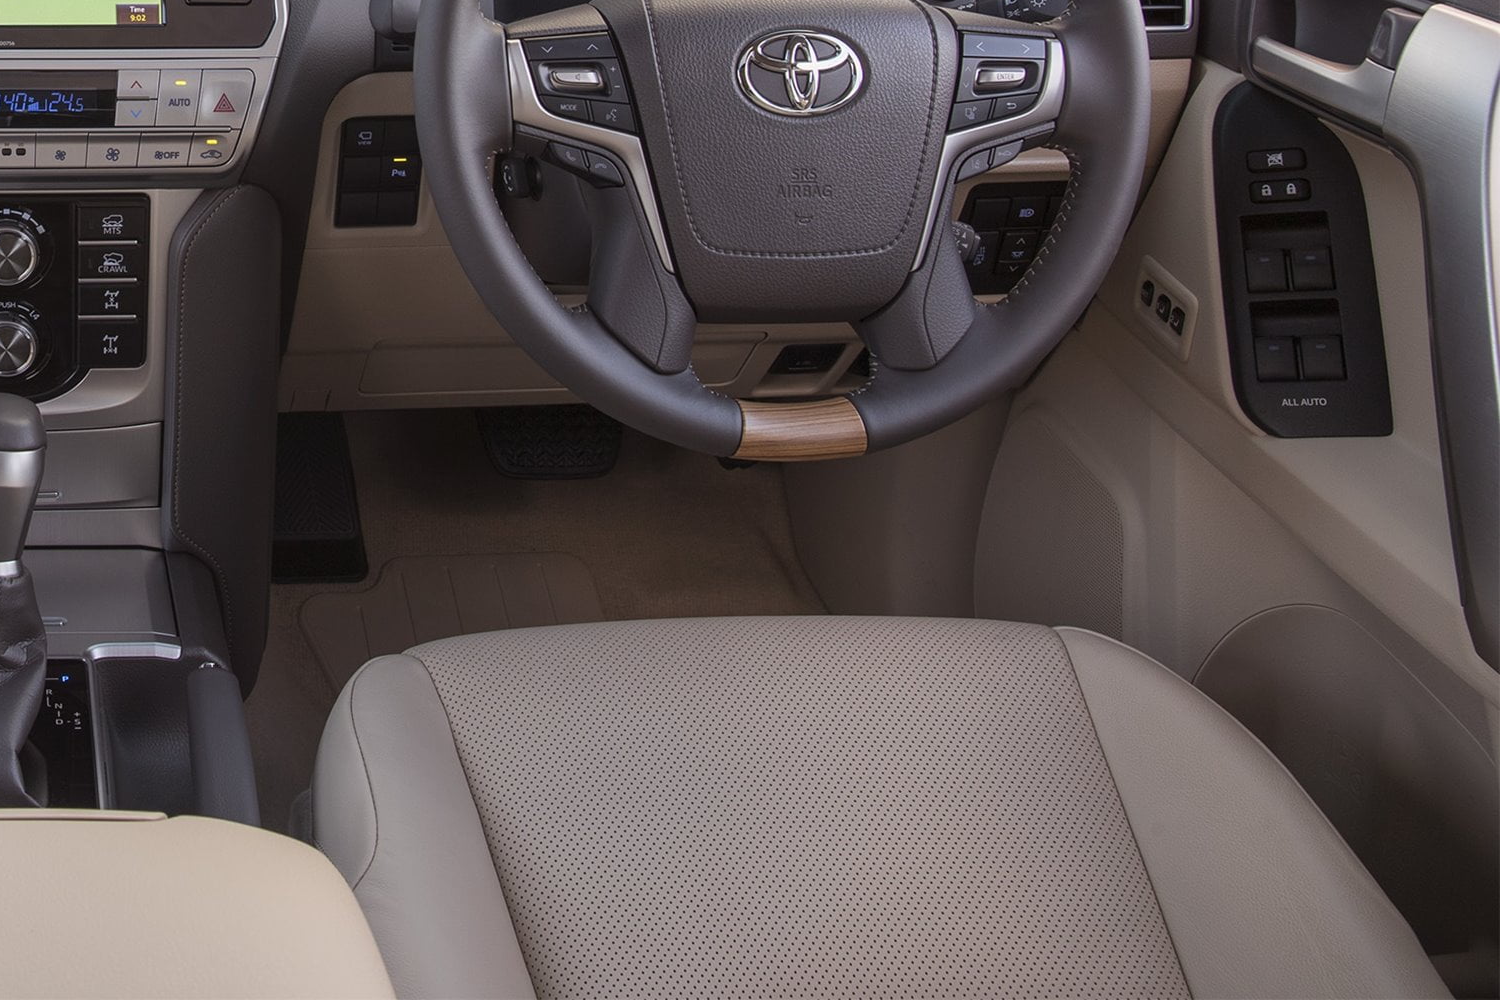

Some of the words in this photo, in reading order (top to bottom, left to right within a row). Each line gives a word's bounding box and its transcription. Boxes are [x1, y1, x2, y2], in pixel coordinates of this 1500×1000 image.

[130, 14, 147, 22] 9:02
[48, 92, 84, 112] 24.5
[168, 98, 190, 106] AUTO
[164, 151, 180, 159] OFF
[790, 168, 818, 180] SRS
[777, 184, 833, 199] AIRBAG
[103, 227, 121, 235] MTS
[98, 265, 128, 273] CRAWL
[29, 310, 39, 321] L4
[1282, 397, 1299, 407] ALL
[1300, 397, 1327, 407] AUTO
